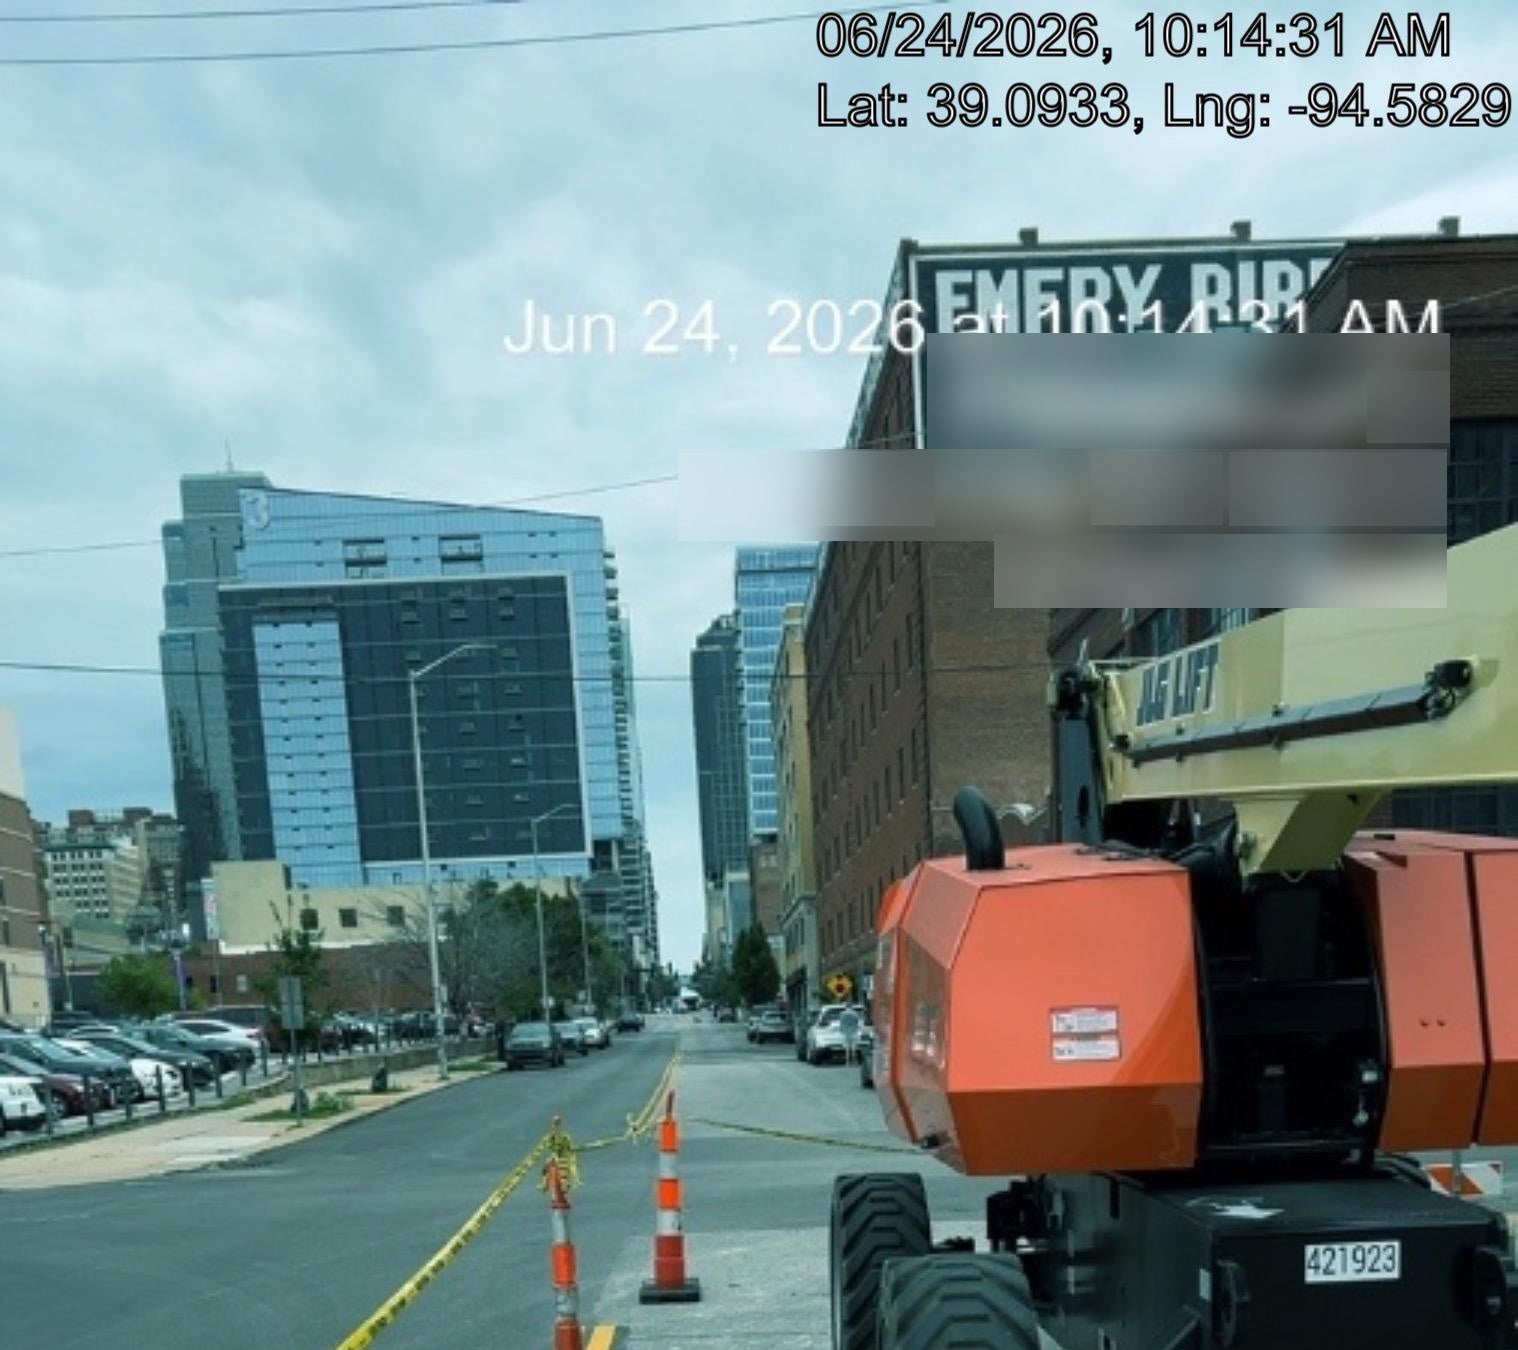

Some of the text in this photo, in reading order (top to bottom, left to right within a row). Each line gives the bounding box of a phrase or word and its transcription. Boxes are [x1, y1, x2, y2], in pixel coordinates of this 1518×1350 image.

[935, 257, 1333, 333] EMERY BIR
[1306, 1244, 1396, 1276] 421923
